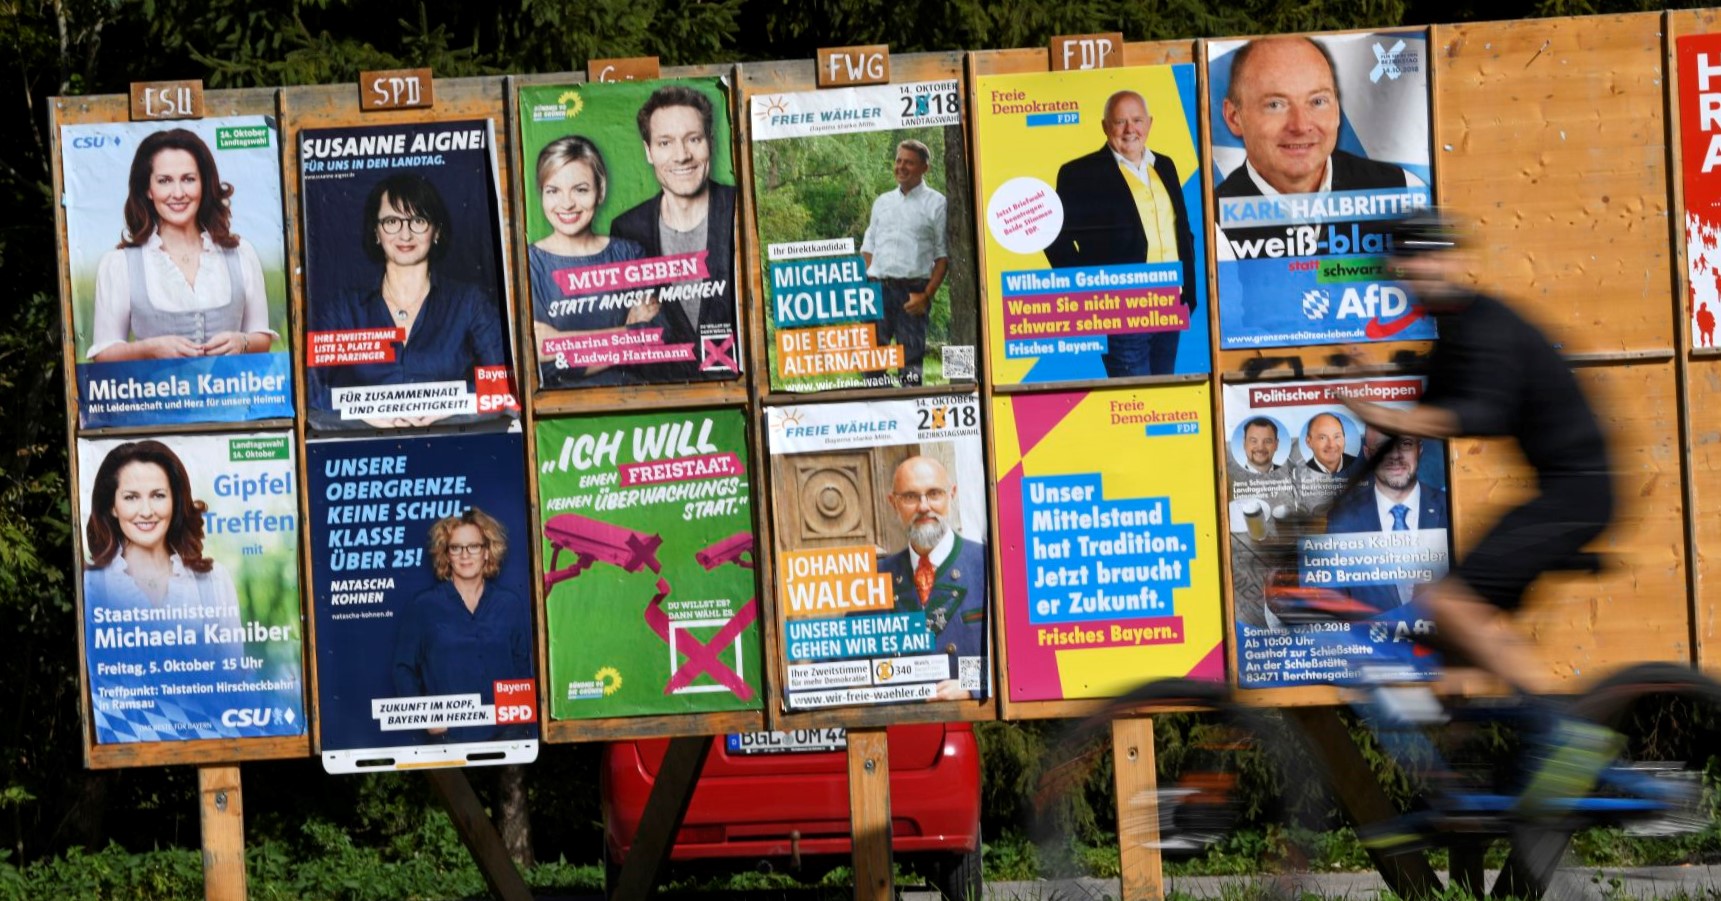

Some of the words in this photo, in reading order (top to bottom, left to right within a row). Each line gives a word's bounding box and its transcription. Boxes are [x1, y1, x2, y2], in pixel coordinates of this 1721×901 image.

[1063, 39, 1112, 70] FDP
[830, 53, 883, 81] FWG
[374, 77, 420, 105] SPD
[916, 82, 958, 93] OKTOBER
[992, 89, 1025, 101] Freie
[992, 100, 1079, 114] Demokraten
[772, 113, 815, 126] FREIE
[821, 108, 881, 123] WÄHLER
[1058, 115, 1077, 123] FDP
[73, 136, 105, 149] CSU
[220, 138, 266, 147] Landtagswahl
[304, 134, 405, 158] SUSANNE
[1223, 201, 1285, 222] KARL
[1292, 193, 1426, 218] HALBRITTER
[568, 269, 619, 291] MUT
[625, 257, 698, 282] GEBEN
[775, 261, 862, 288] MICHAEL
[1007, 273, 1070, 291] Wilhelm
[1076, 270, 1177, 287] Gschossmann
[548, 296, 598, 317] STATT
[599, 289, 654, 310] ANGST
[658, 280, 726, 302] MACHEN
[777, 287, 877, 322] KOLLER
[1008, 301, 1051, 315] Wenn
[1057, 297, 1079, 313] Sie
[1085, 294, 1120, 311] nicht
[1125, 292, 1175, 308] weiter
[1337, 284, 1407, 320] AfD
[1010, 319, 1070, 334] schwarz
[1076, 314, 1121, 330] sehen
[1127, 311, 1183, 327] wollen.
[314, 333, 334, 343] IHRE
[336, 331, 396, 341] ZWEITSTIMME
[545, 339, 608, 352] Katharina
[612, 333, 659, 346] Schulze
[782, 332, 810, 351] DIE
[818, 327, 870, 350] ECHTE
[1228, 329, 1364, 344] www.grenzen-schützen-leben.de
[1009, 342, 1054, 355] Frisches
[1058, 341, 1103, 354] Bayern.
[784, 348, 898, 375] ALTERNATIVE
[89, 376, 190, 401] Michaela
[198, 372, 285, 395] Kaniber
[340, 391, 360, 403] FÜR
[365, 387, 459, 401] ZUSAMMENHALT
[1254, 389, 1320, 403] Politischer
[1324, 385, 1416, 399] Frühschoppen
[89, 405, 104, 413] Mit
[106, 401, 162, 412] Leidenschaft
[165, 402, 181, 410] und
[184, 400, 203, 408] Herz
[207, 399, 219, 407] für
[222, 398, 250, 406] unsere
[253, 395, 285, 404] Heimat
[350, 404, 374, 414] UND
[378, 400, 467, 413] GERECHTIGKEIT!
[916, 399, 929, 407] 14.
[932, 396, 975, 406] OKTOBER
[1110, 400, 1144, 412] Freie
[1111, 410, 1198, 425] Demokraten
[786, 425, 829, 437] FREIE
[836, 420, 897, 434] WÄHLER
[918, 428, 979, 439] BEZIRKSTAGSWAHL
[1177, 424, 1197, 433] FDP
[232, 441, 283, 449] Landtagswahl
[325, 456, 407, 477] UNSERE
[579, 472, 617, 488] EINEN
[629, 456, 735, 483] FREISTAAT,
[214, 472, 291, 501] Gipfel
[326, 476, 472, 501] OBERGRENZE.
[547, 494, 593, 511] KEINEN
[595, 477, 748, 511] ÜBERWACHUNGS-
[1030, 482, 1094, 504] Unser
[327, 504, 389, 524] KEINE
[396, 500, 471, 520] SCHUL-
[1033, 502, 1162, 532] Mittelstand
[203, 511, 294, 534] Treffen
[329, 527, 405, 547] KLASSE
[1033, 537, 1071, 559] hat
[1078, 532, 1187, 556] Tradition.
[242, 545, 262, 555] mit
[1305, 551, 1444, 567] Landesvorsitzender
[330, 549, 385, 571] ÜBER
[392, 548, 422, 567] 25!
[787, 552, 870, 583] JOHANN
[1035, 566, 1089, 588] Jetzt
[1097, 558, 1182, 584] braucht
[1305, 571, 1331, 583] AfD
[1337, 567, 1432, 582] Brandenburg
[331, 577, 394, 591] NATASCHA
[332, 592, 384, 605] KOHNEN
[788, 577, 886, 611] WALCH
[1037, 599, 1060, 615] er
[1068, 587, 1165, 614] Zukunft.
[94, 604, 238, 623] Staatsministerin
[668, 602, 679, 610] DU
[681, 600, 713, 609] WILLST
[332, 610, 393, 620] natascha-kohnen.de
[95, 625, 196, 648] Michaela
[204, 621, 291, 644] Kaniber
[790, 621, 846, 639] UNSERE
[852, 616, 909, 635] HEIMAT
[1038, 626, 1104, 646] Frisches
[1111, 625, 1177, 644] Bayern.
[791, 641, 840, 658] GEHEN
[845, 638, 880, 655] WIR
[883, 637, 897, 650] ES
[903, 634, 930, 650] AN!
[1245, 639, 1259, 648] Ab
[1264, 637, 1292, 646] 10:00
[1296, 638, 1315, 646] Uhr
[1245, 648, 1287, 659] Gasthof
[1290, 650, 1307, 658] zur
[1310, 646, 1373, 658] Schießstätte
[98, 663, 146, 675] Freitag,
[150, 661, 160, 673] 5.
[164, 659, 214, 671] Oktober
[222, 659, 236, 669] 15
[240, 657, 263, 669] Uhr
[791, 667, 808, 677] Ihre
[811, 666, 867, 676] Zweitstimme
[895, 665, 911, 675] 340
[1246, 662, 1260, 671] An
[1264, 661, 1281, 670] der
[1285, 659, 1347, 669] Schießstätte
[1247, 672, 1278, 682] 83471
[1283, 668, 1360, 681] Berchtesgaden
[496, 683, 530, 694] Bayern
[795, 687, 930, 704] www.wir-freie-waehler.de
[99, 702, 108, 710] in
[112, 699, 154, 709] Ramsau
[498, 705, 532, 722] SPD
[222, 708, 270, 727] CSU
[388, 714, 427, 724] BAYERN
[431, 713, 444, 722] IM
[447, 711, 489, 722] HERZEN.
[742, 732, 780, 746] BGL
